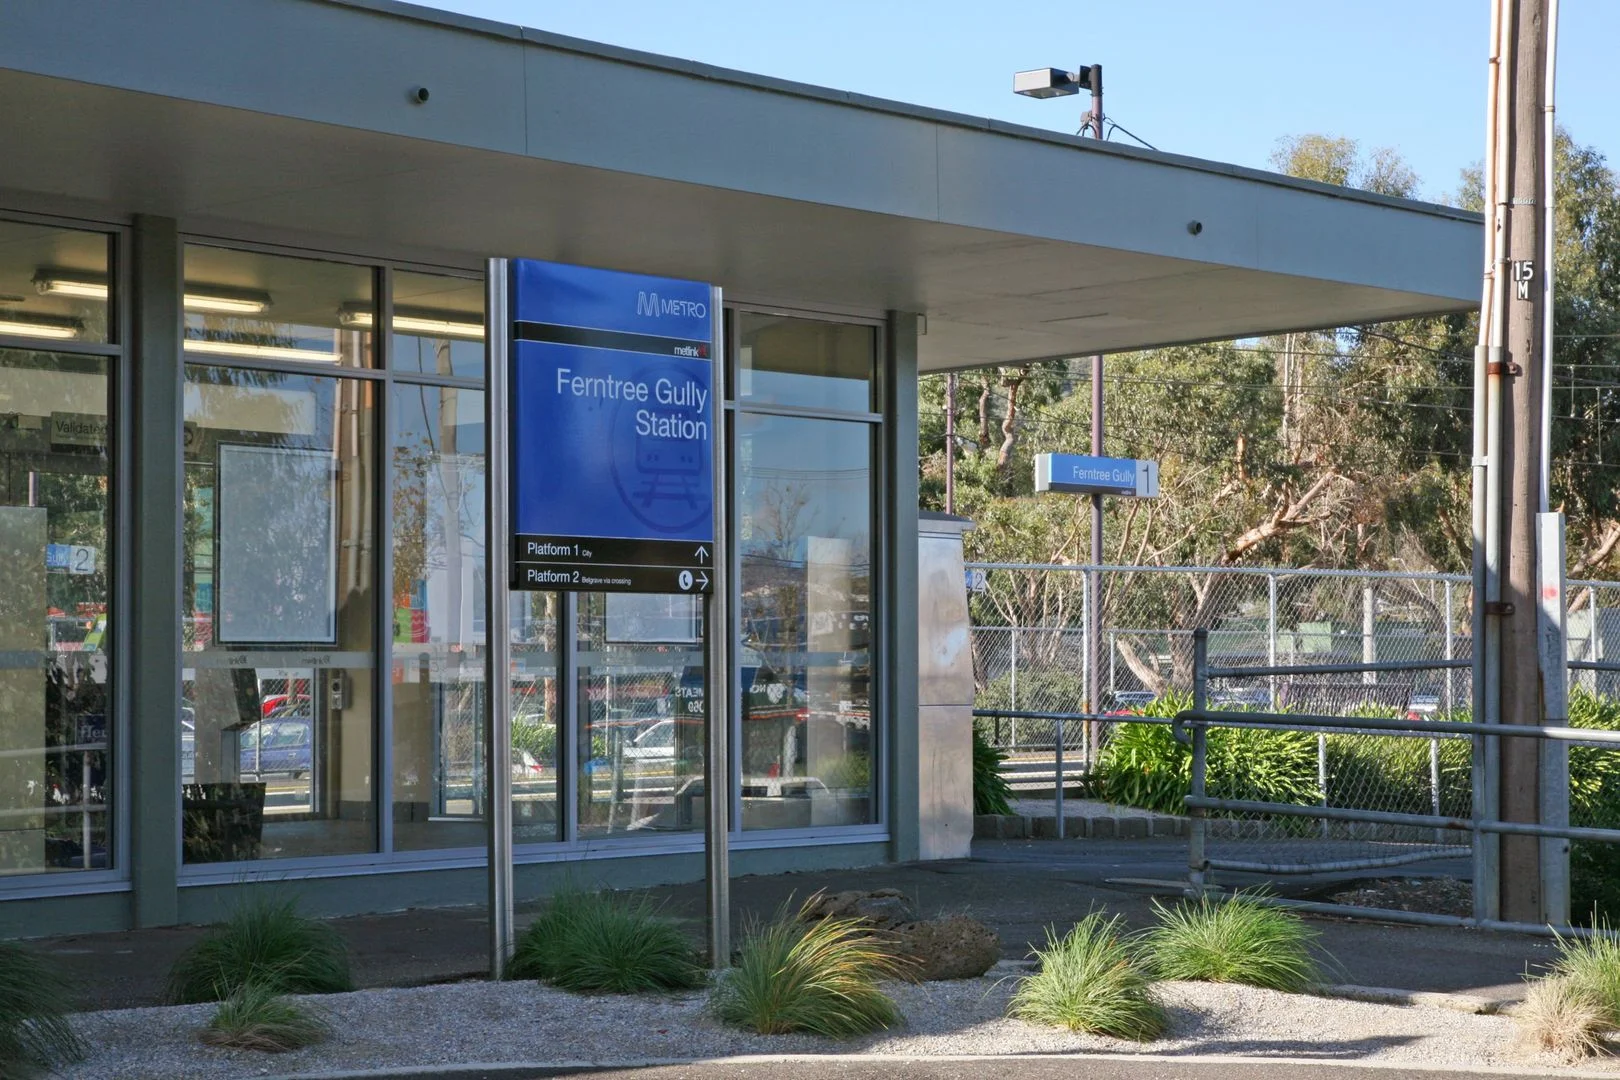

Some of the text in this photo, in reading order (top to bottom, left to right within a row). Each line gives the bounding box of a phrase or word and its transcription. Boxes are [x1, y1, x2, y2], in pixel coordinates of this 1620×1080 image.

[1515, 261, 1534, 281] 15
[1518, 281, 1528, 299] M
[661, 298, 706, 318] METRO
[674, 345, 699, 357] metlink
[557, 367, 708, 414] Ferntree Gully
[635, 409, 707, 441] Station
[1072, 465, 1135, 486] Ferntree Gully
[1142, 464, 1150, 493] 1
[75, 548, 89, 571] 2
[527, 542, 593, 558] Platform 1 City
[527, 569, 570, 582] Platform
[572, 570, 580, 583] 2
[581, 576, 603, 585] Belgrave
[611, 578, 632, 586] crossing
[975, 572, 983, 589] 2
